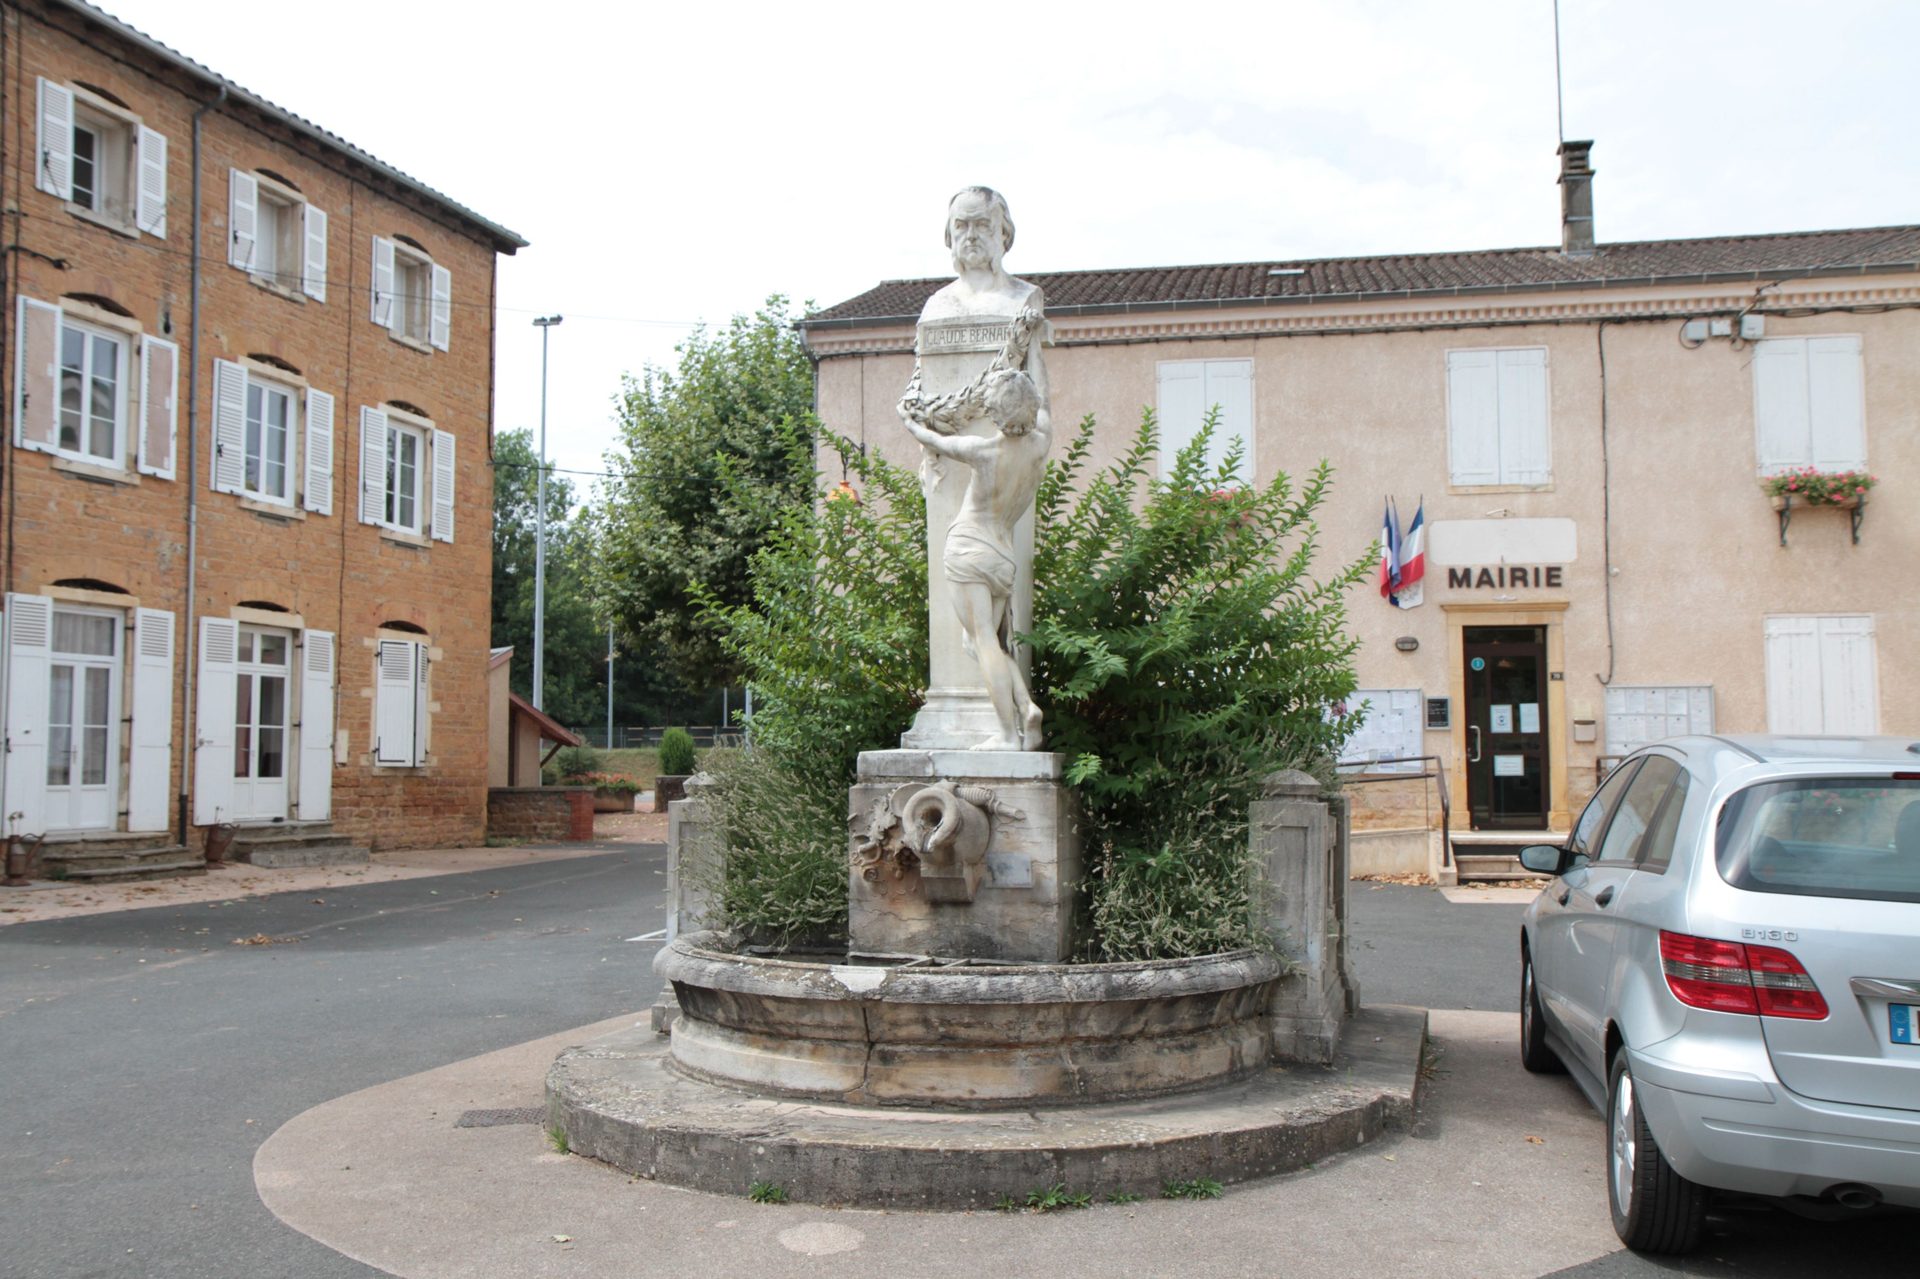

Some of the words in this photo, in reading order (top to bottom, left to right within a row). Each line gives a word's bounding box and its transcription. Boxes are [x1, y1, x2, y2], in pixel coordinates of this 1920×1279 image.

[927, 329, 967, 345] CLAUDE
[1448, 566, 1563, 589] MAIRIE
[1897, 1027, 1905, 1037] F
